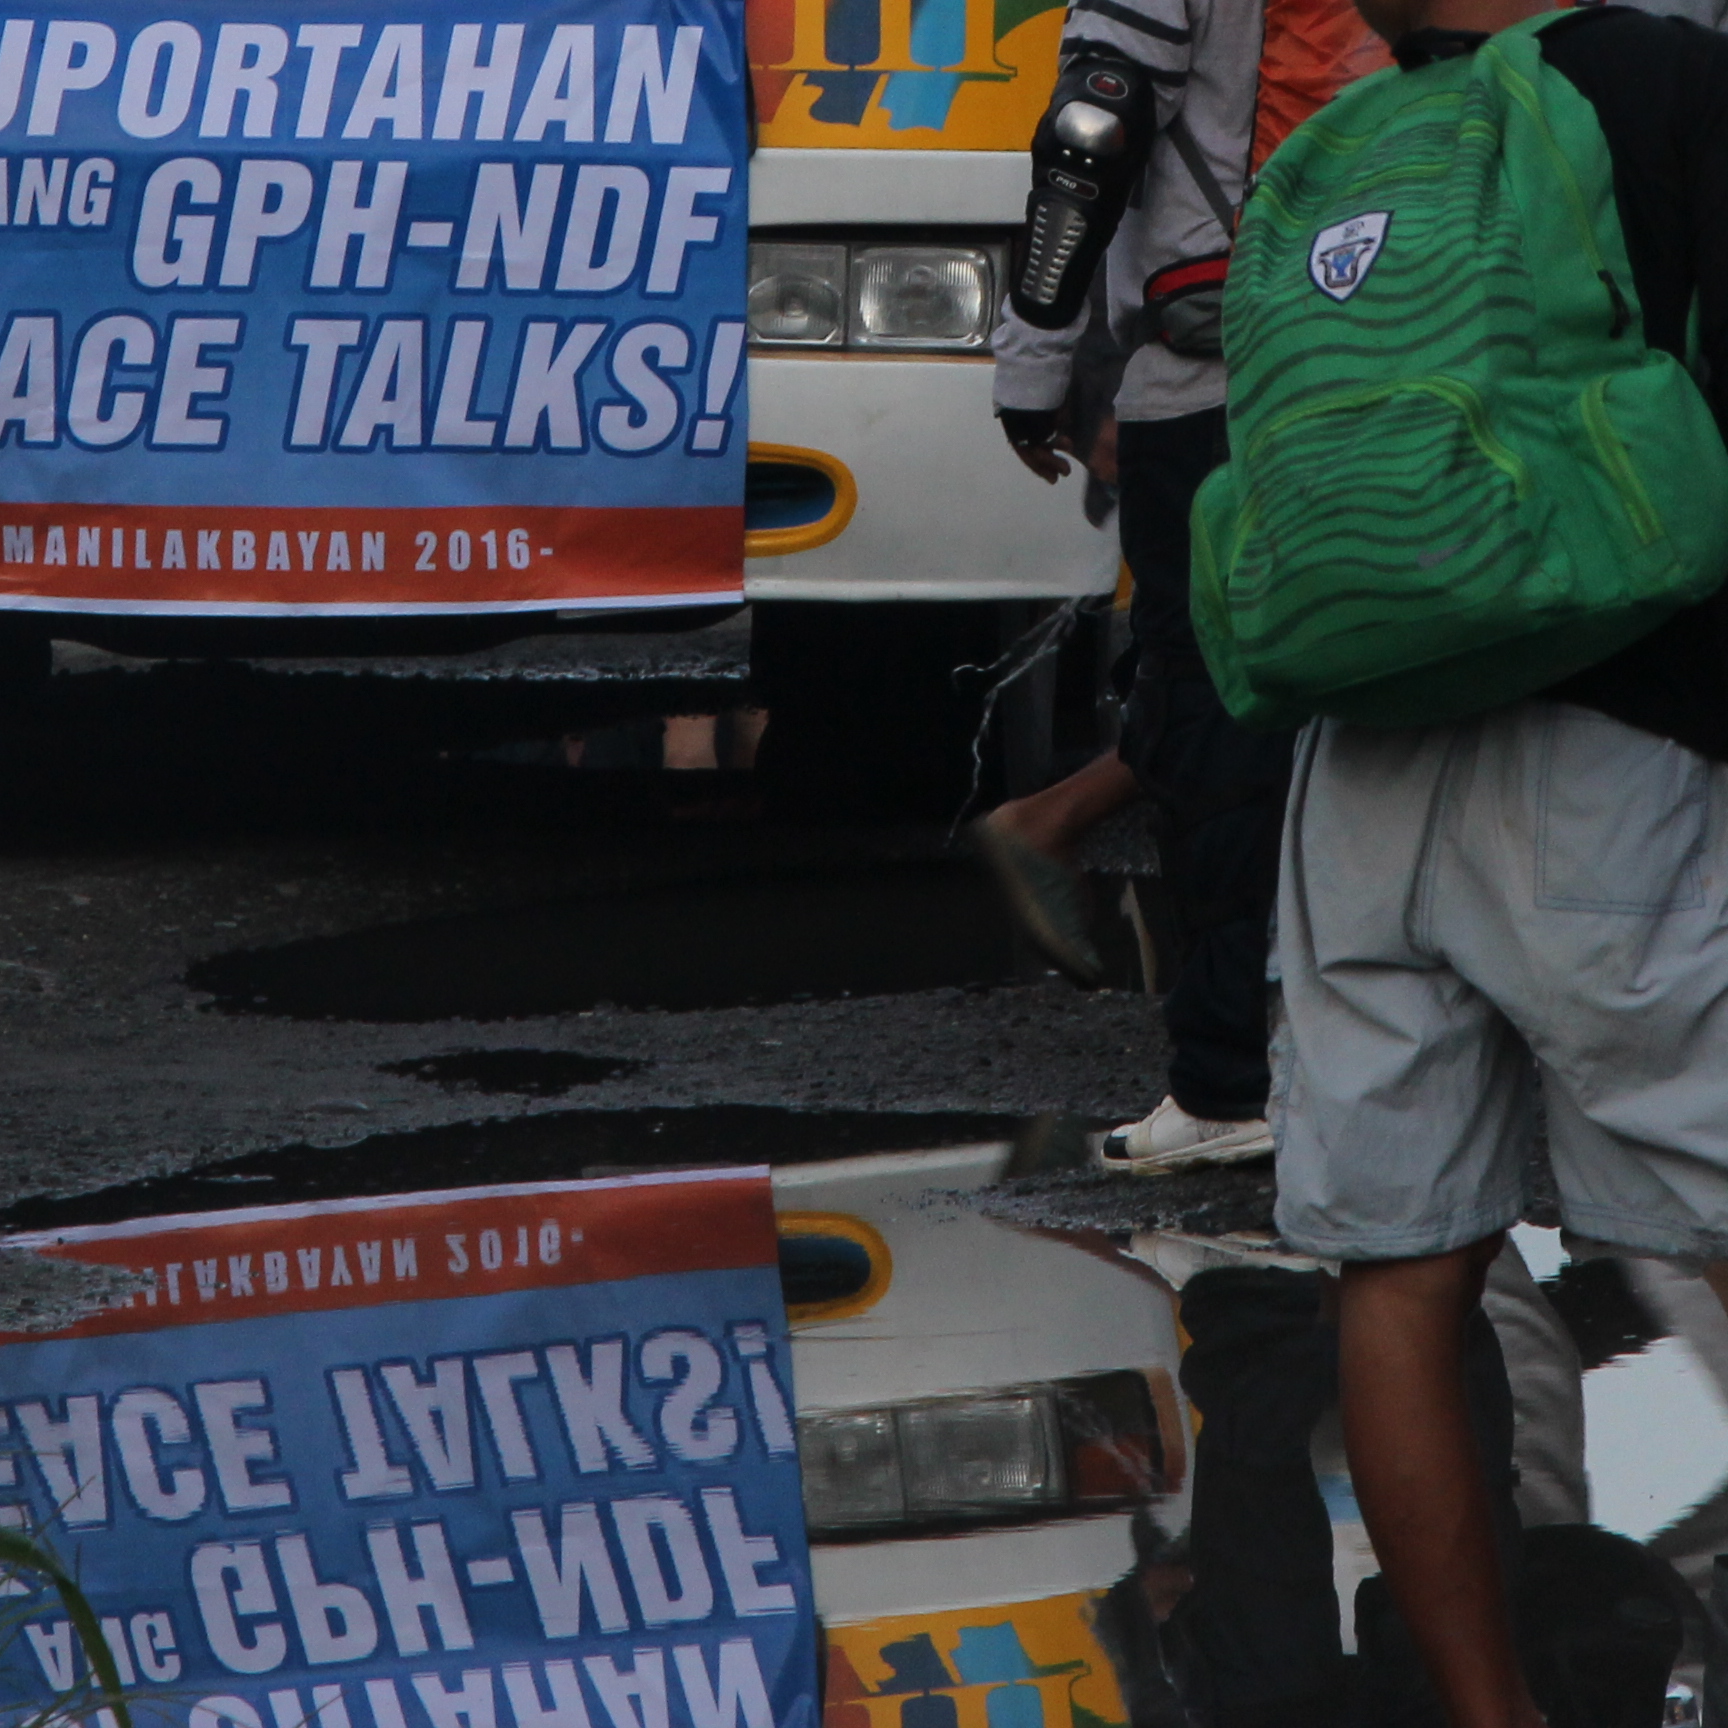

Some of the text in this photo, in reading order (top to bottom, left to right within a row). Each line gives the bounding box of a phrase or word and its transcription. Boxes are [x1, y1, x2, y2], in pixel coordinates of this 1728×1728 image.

[132, 157, 732, 293] GPH-NDF
[1055, 175, 1078, 190] PRO
[286, 318, 746, 452] TALKS!
[414, 527, 555, 572] 2016-
